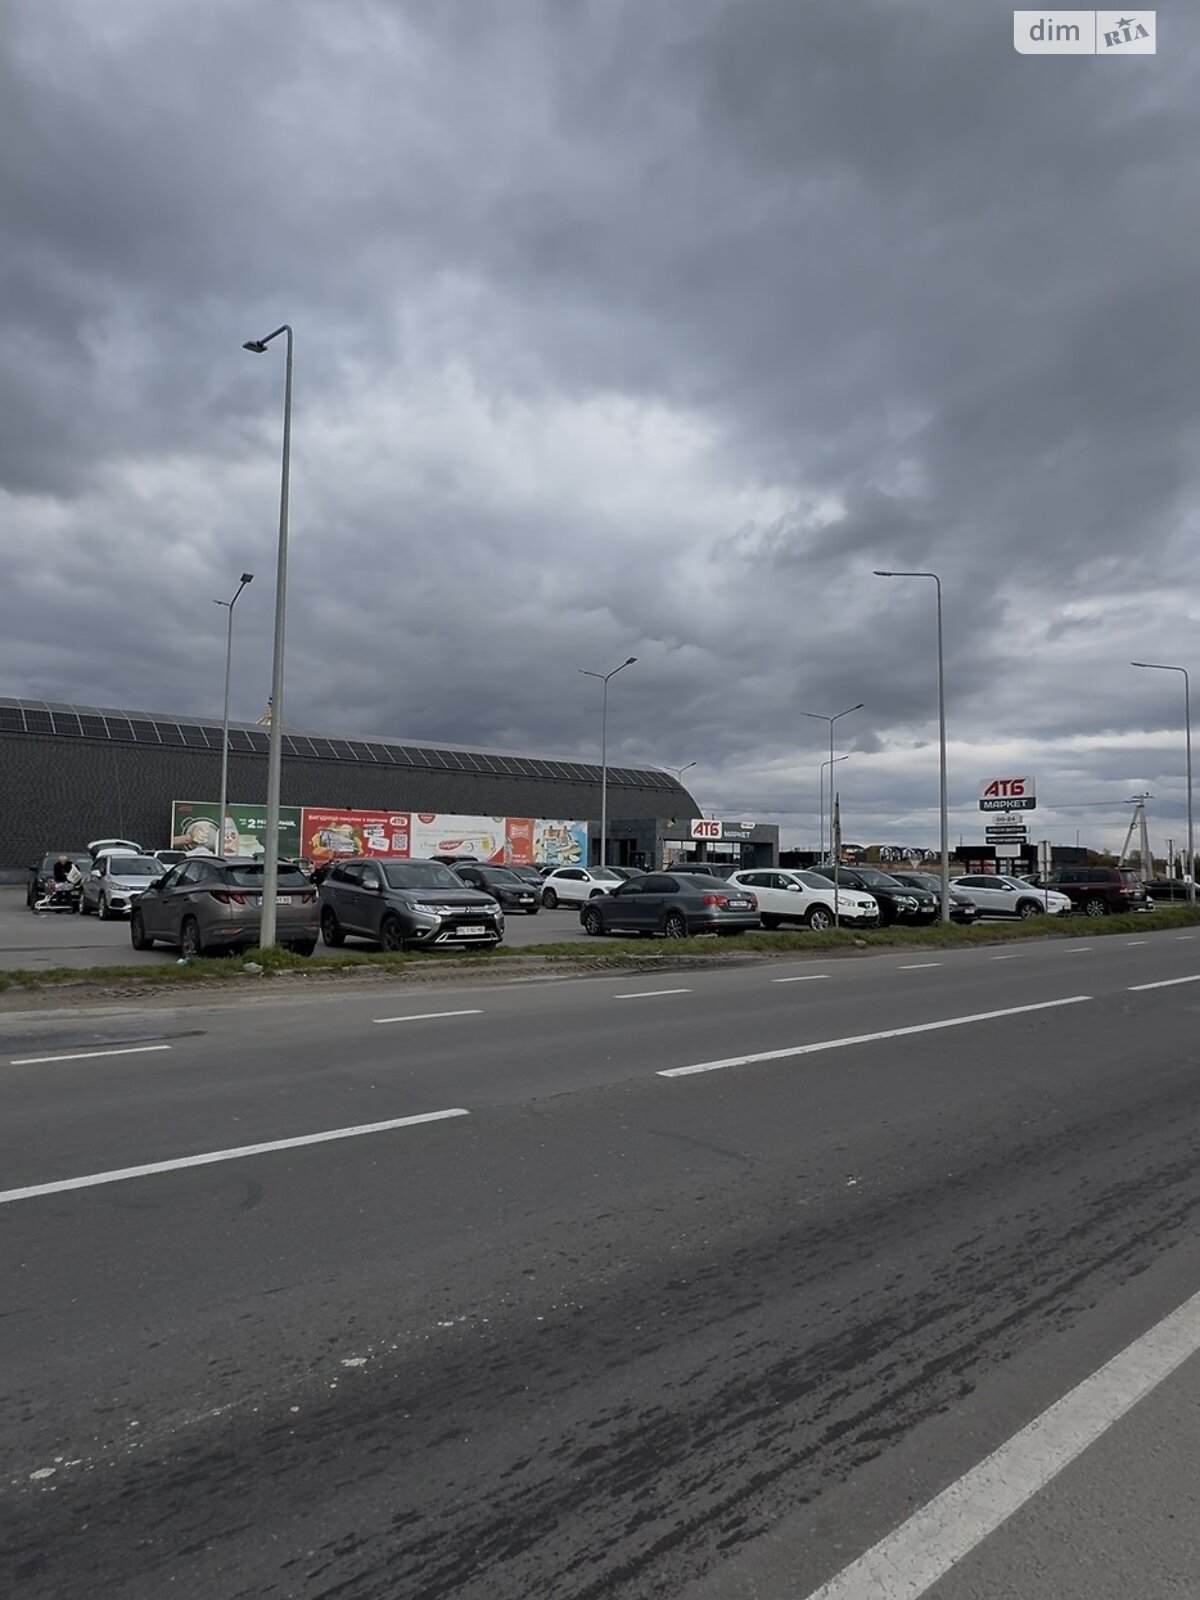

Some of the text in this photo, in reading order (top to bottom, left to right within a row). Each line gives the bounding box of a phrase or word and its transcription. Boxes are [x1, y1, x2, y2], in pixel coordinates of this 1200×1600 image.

[984, 779, 1026, 797] АТБ
[984, 800, 1028, 809] МАРКЕТ
[247, 818, 256, 829] 2
[693, 822, 720, 836] АТБ
